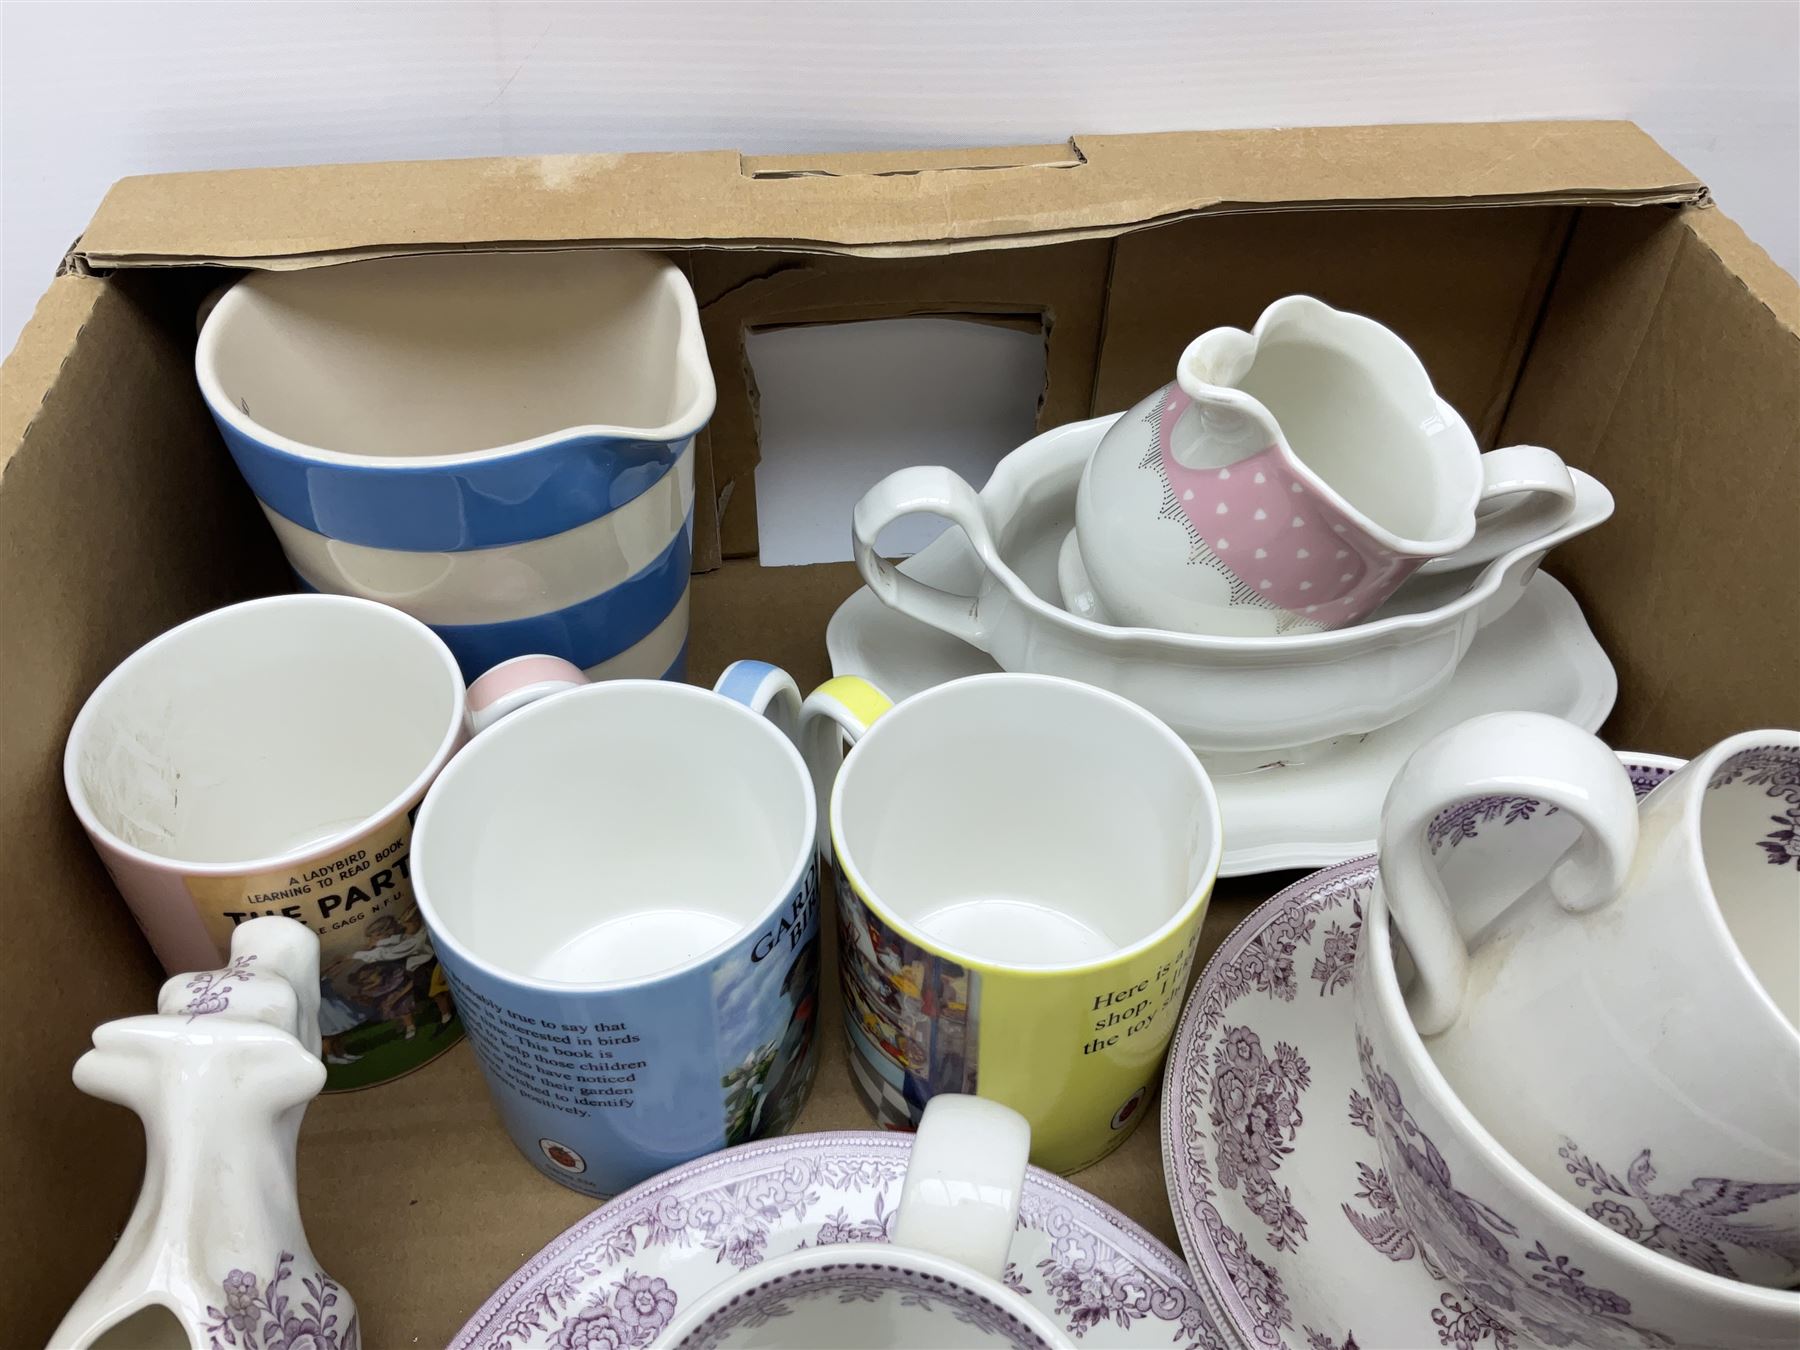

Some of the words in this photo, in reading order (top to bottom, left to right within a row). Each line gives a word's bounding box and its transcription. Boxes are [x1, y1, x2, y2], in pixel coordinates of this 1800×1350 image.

[247, 885, 311, 904] LEARNING
[317, 878, 333, 889] TO
[340, 861, 370, 880] READ
[375, 838, 404, 862] BOOK
[289, 877, 299, 886] A
[303, 850, 366, 882] LADYBIRD
[317, 853, 409, 919] PART
[332, 912, 365, 930] GAGG
[751, 850, 818, 963] GARD
[1092, 980, 1149, 1011] Here
[1155, 963, 1170, 981] is
[507, 1009, 536, 1025] true
[541, 1020, 556, 1029] to
[561, 1024, 587, 1034] say
[595, 1022, 626, 1032] that
[1095, 1000, 1152, 1031] shop.
[500, 1018, 571, 1044] interested
[577, 1036, 592, 1046] in
[598, 1034, 641, 1046] birds
[515, 1034, 549, 1052] This
[553, 1046, 593, 1058] book
[600, 1049, 613, 1058] is
[1083, 1032, 1120, 1055] the
[1128, 1009, 1158, 1037] toy
[501, 1038, 530, 1058] help
[534, 1054, 575, 1069] those
[580, 1060, 647, 1071] children
[536, 1065, 572, 1080] have
[577, 1073, 636, 1083] noticed
[541, 1078, 574, 1092] their
[580, 1087, 633, 1096] garden
[520, 1089, 591, 1117] positively.
[555, 1093, 569, 1102] to
[574, 1096, 634, 1108] identify
